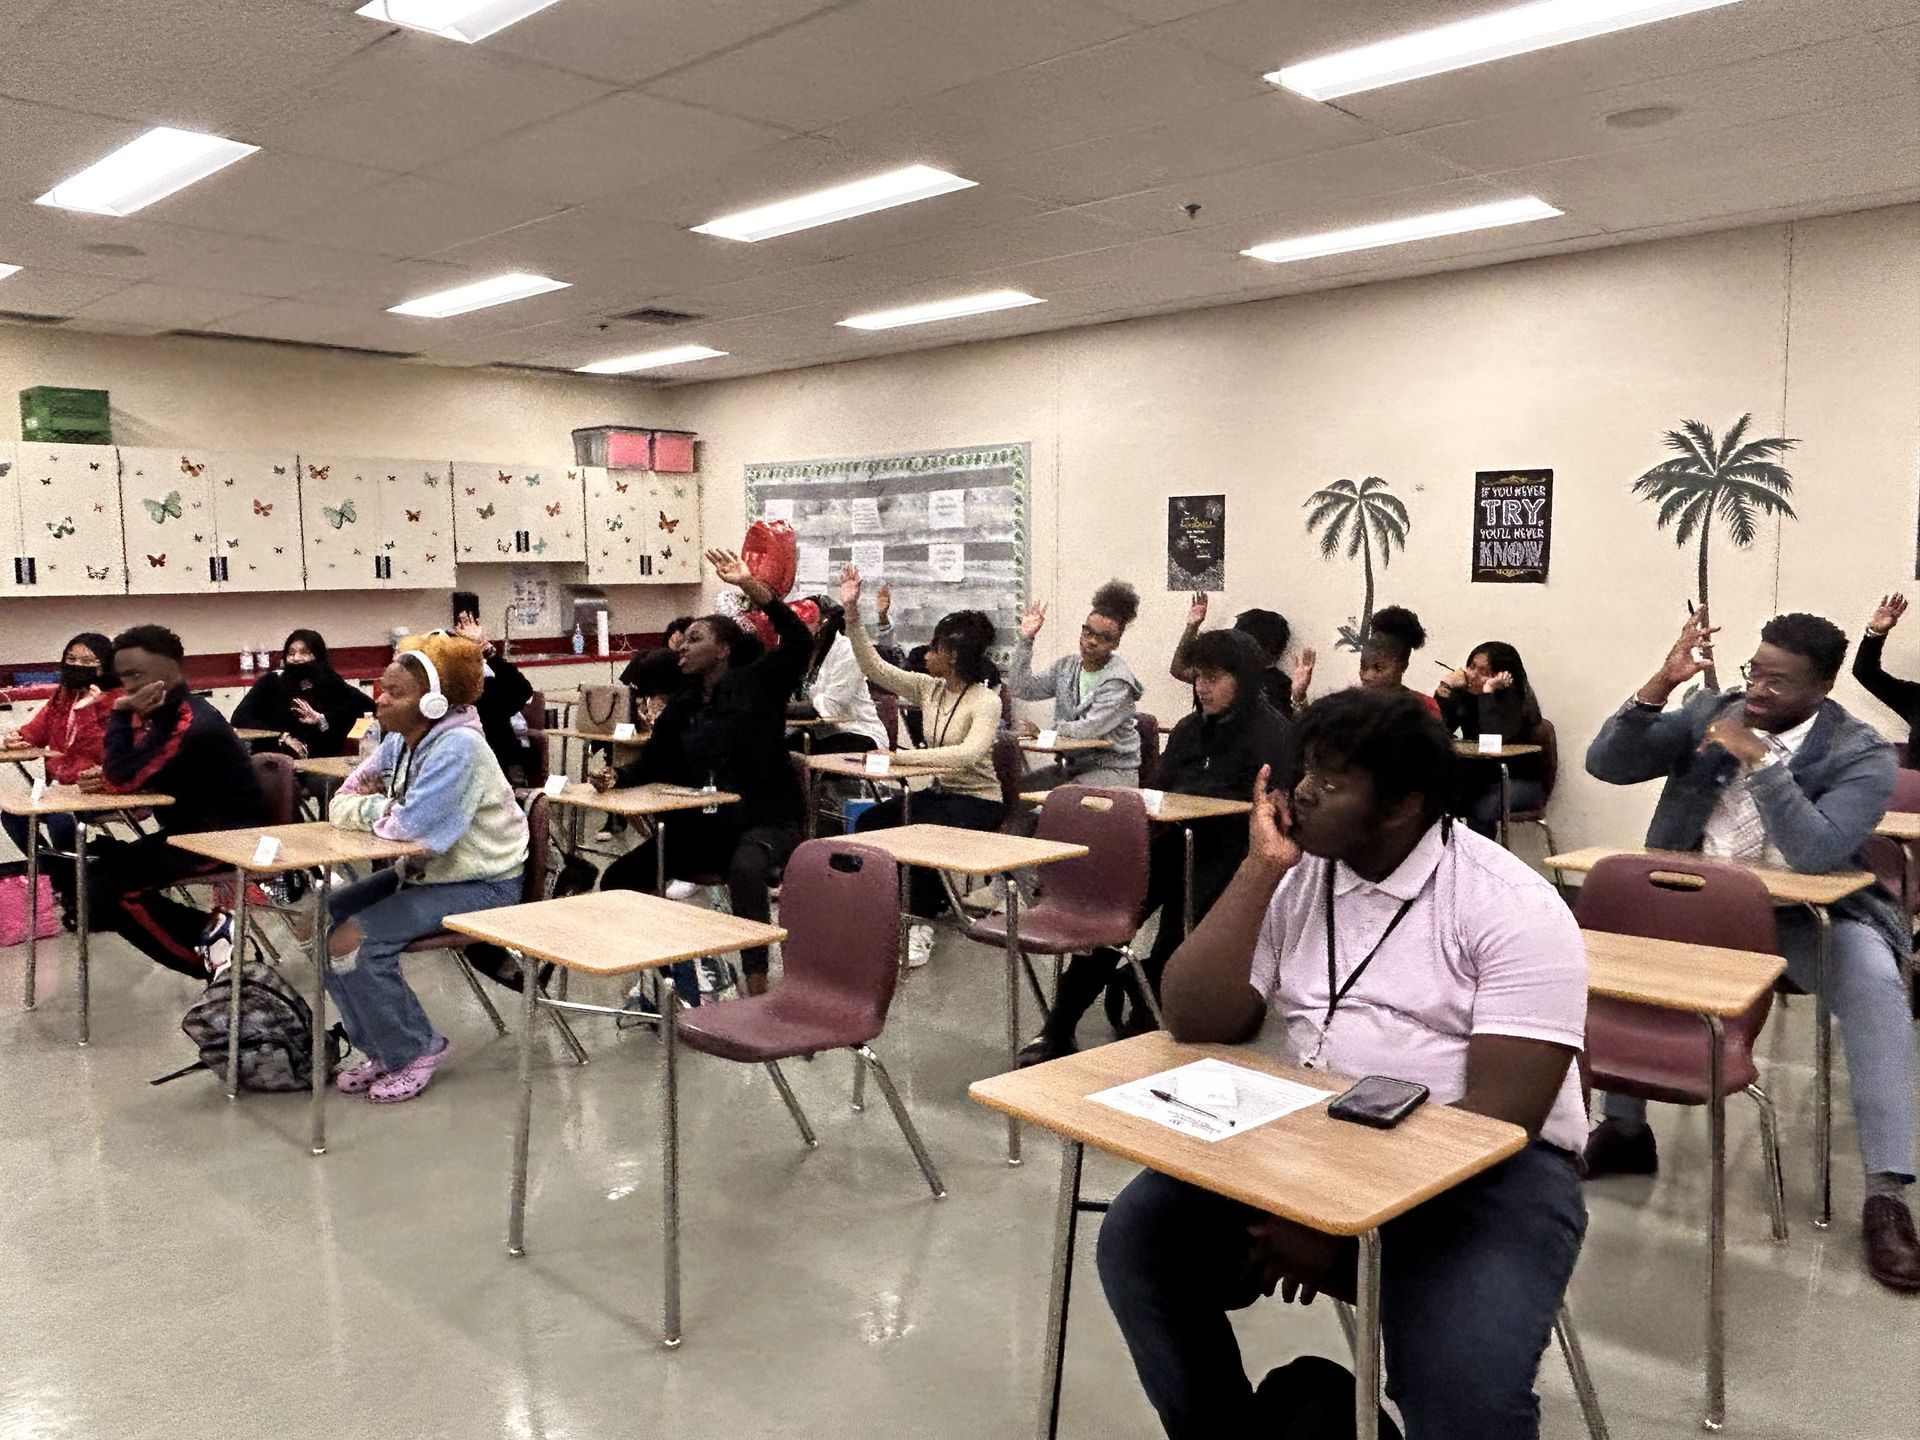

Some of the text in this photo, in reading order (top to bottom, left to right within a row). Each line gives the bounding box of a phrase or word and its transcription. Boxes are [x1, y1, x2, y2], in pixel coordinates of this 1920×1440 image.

[1481, 485, 1546, 498] IF YOU NEVER
[1480, 527, 1545, 539] YOU'LL NEVER
